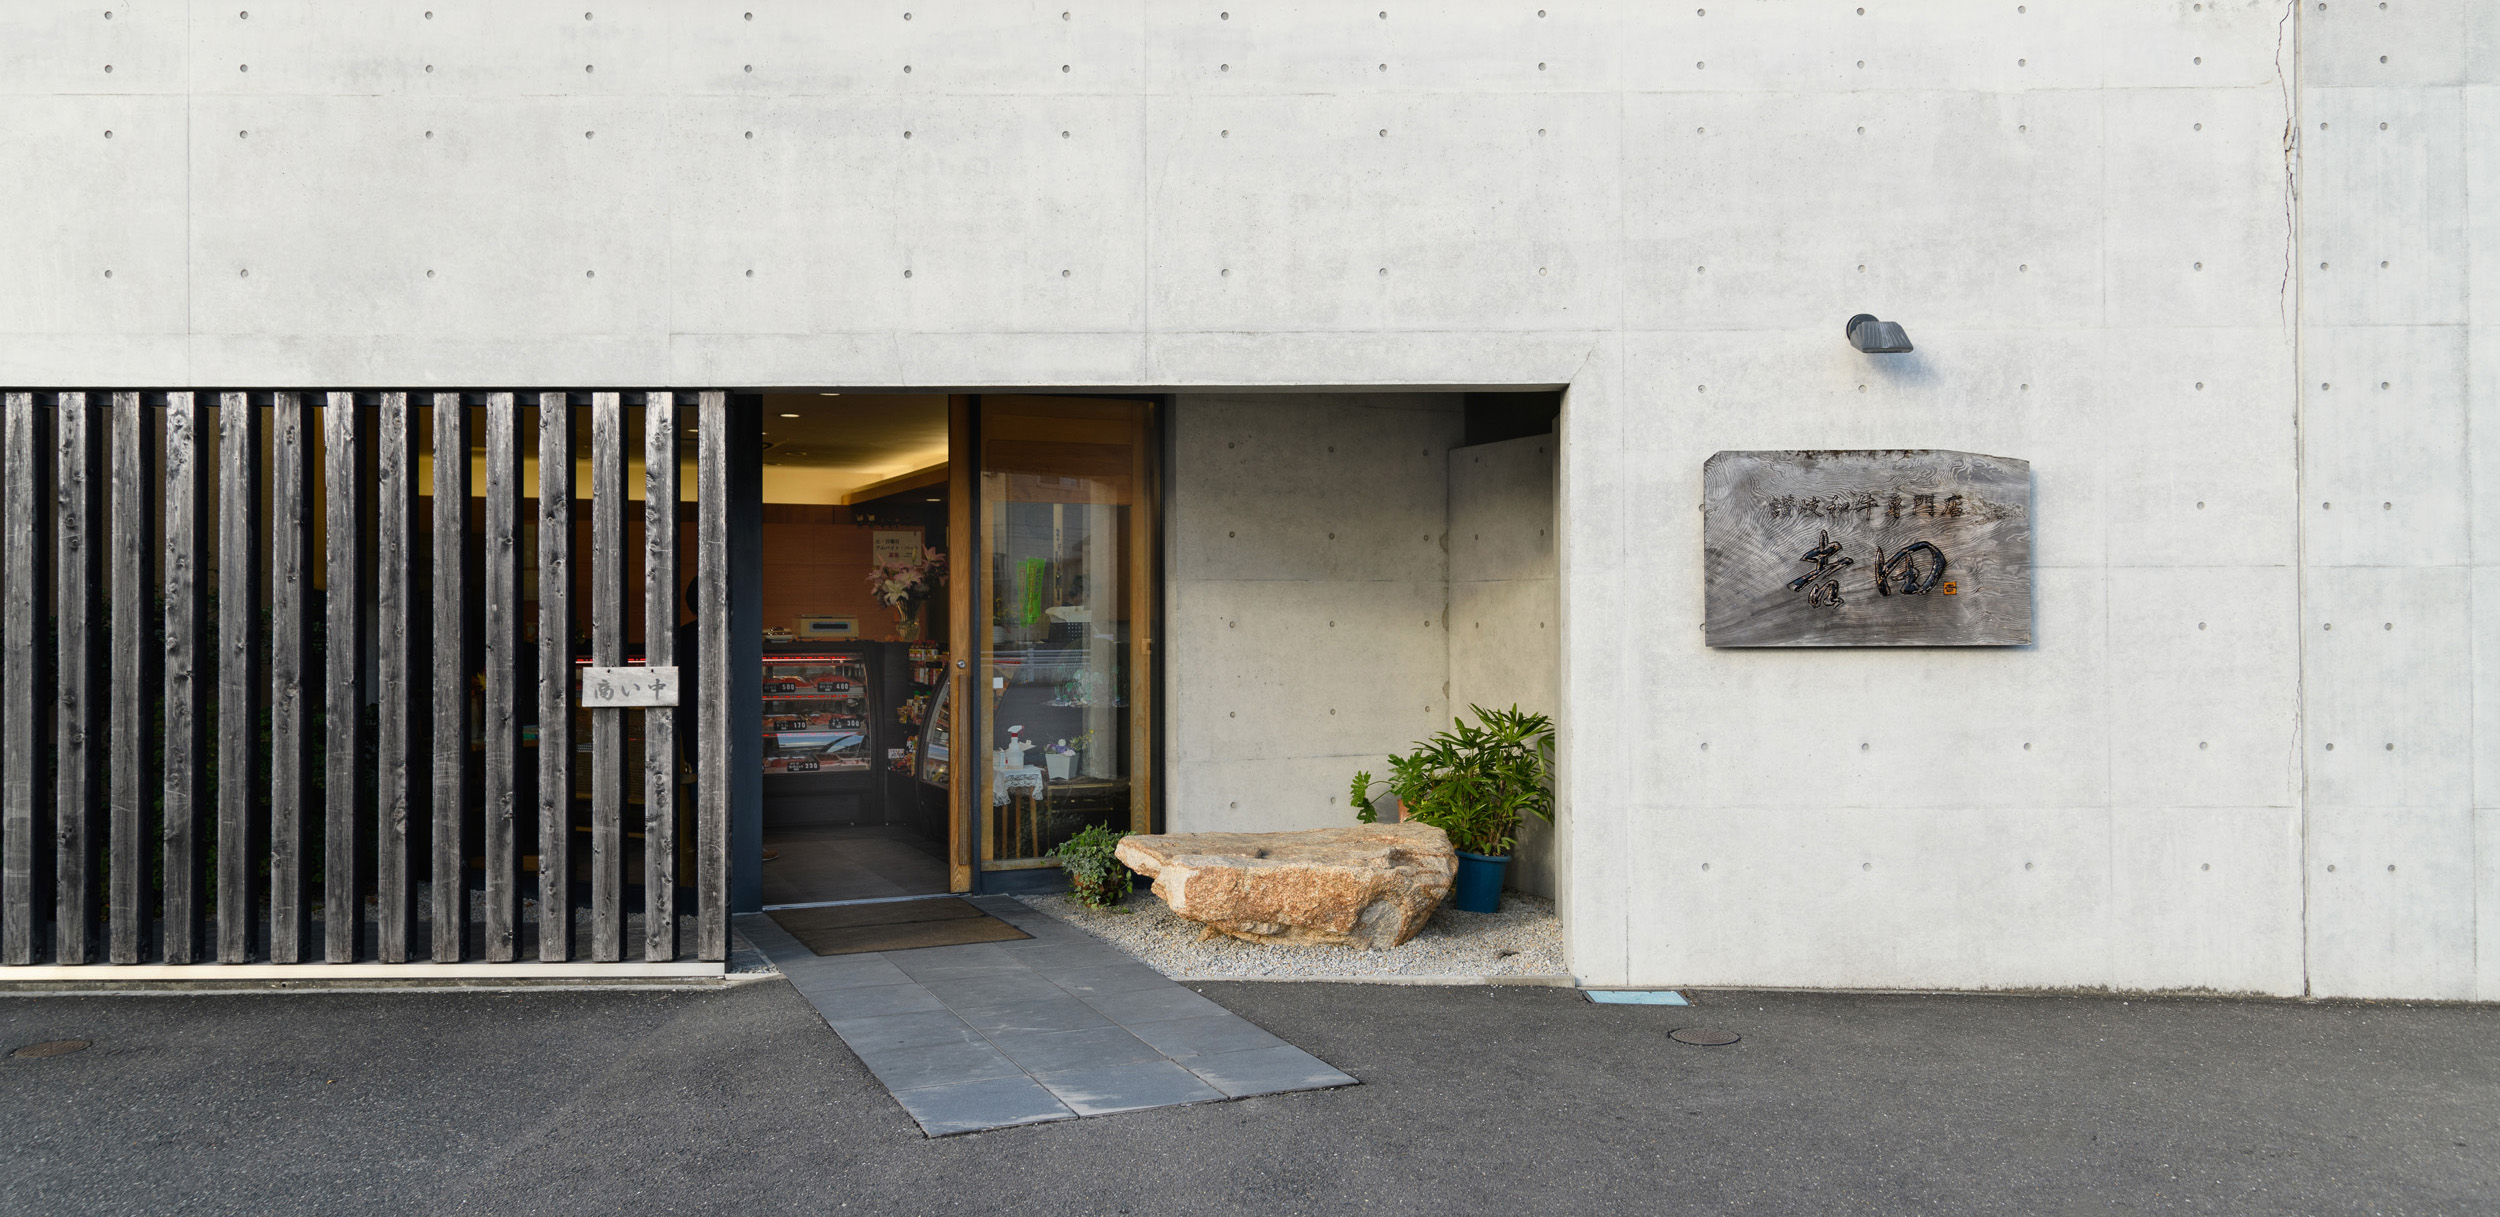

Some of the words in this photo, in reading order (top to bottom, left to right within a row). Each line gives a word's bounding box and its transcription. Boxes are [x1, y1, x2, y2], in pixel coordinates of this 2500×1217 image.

[1787, 529, 1947, 609] 吉田
[594, 678, 667, 701] 商い中
